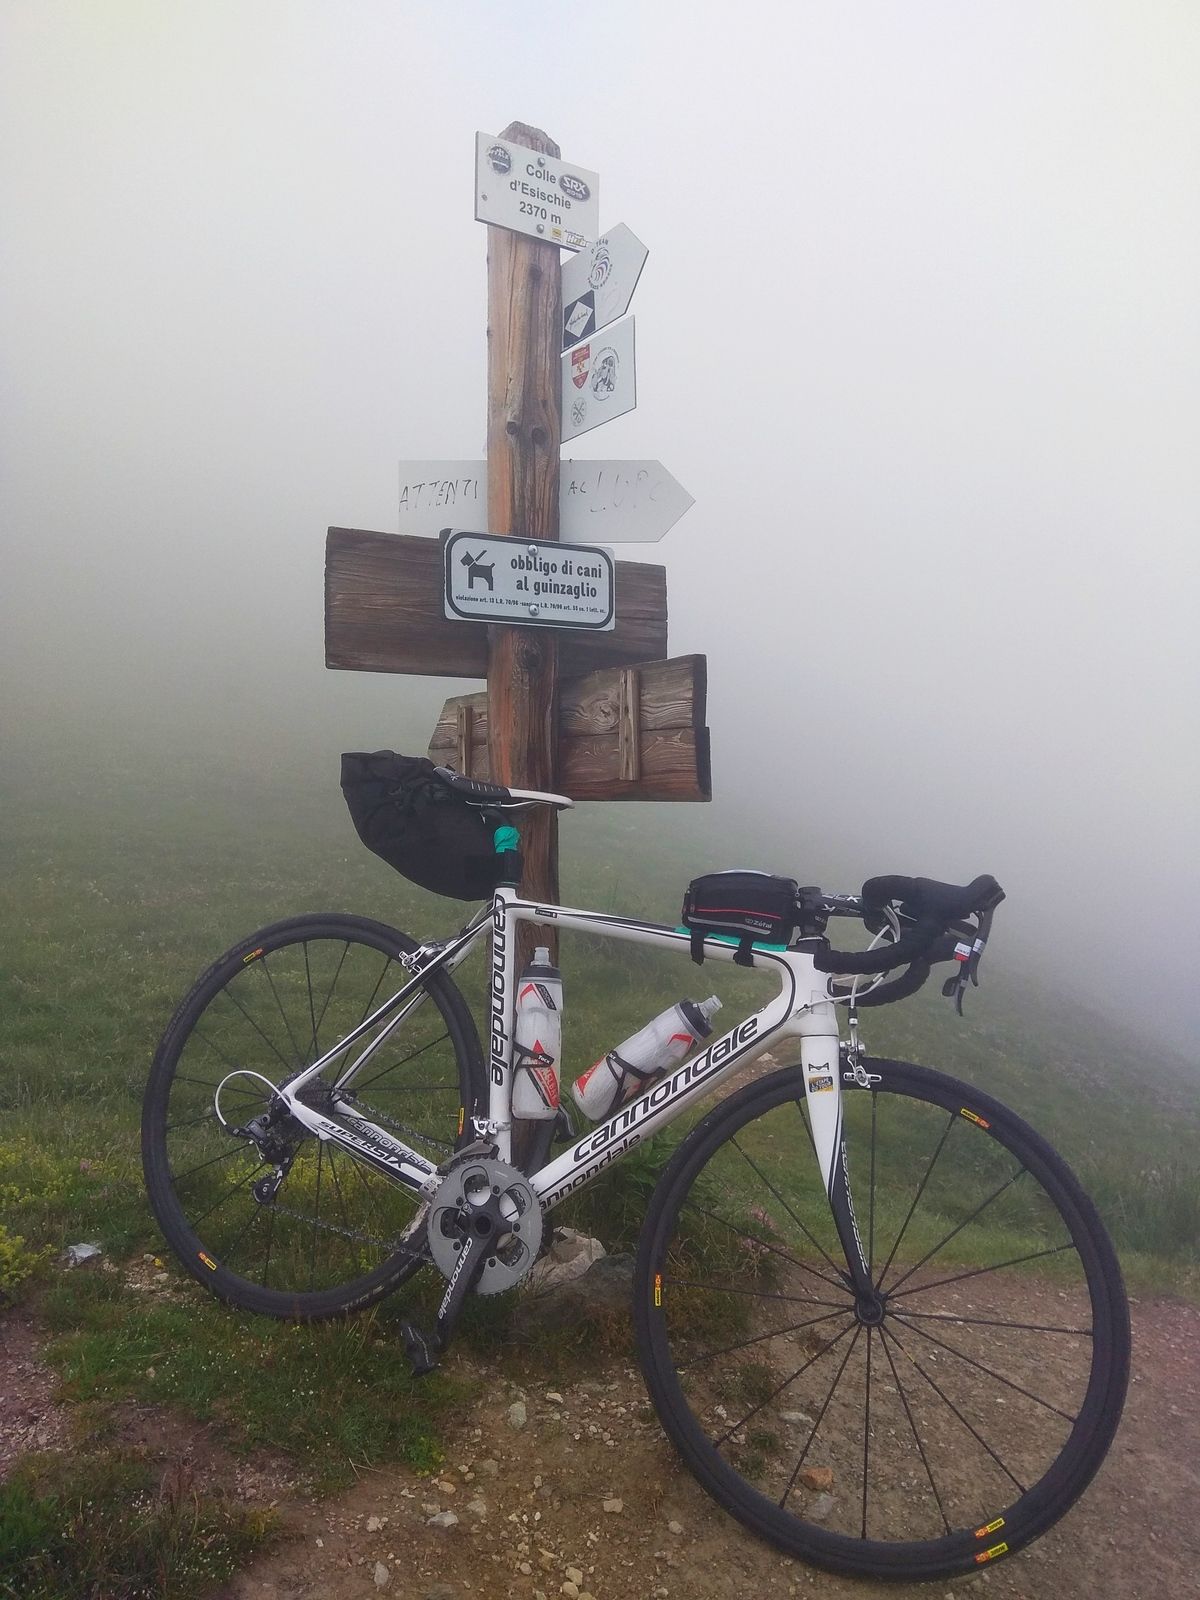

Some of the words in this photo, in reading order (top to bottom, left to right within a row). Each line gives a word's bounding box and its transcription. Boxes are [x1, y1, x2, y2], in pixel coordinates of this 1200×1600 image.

[526, 164, 556, 184] Colle
[563, 176, 586, 195] SRX
[510, 180, 572, 210] d'Esischie
[519, 201, 547, 220] 2370
[551, 213, 562, 225] m
[510, 555, 558, 576] obbligo
[561, 560, 573, 575] di
[577, 564, 602, 579] cani
[516, 575, 529, 591] al
[533, 578, 597, 599] guinzaglio
[491, 893, 508, 1087] cannondale
[573, 1017, 758, 1163] cannondale
[319, 1121, 408, 1168] SUPERSIX
[539, 1134, 641, 1210] annondale
[438, 1237, 473, 1320] cannondale
